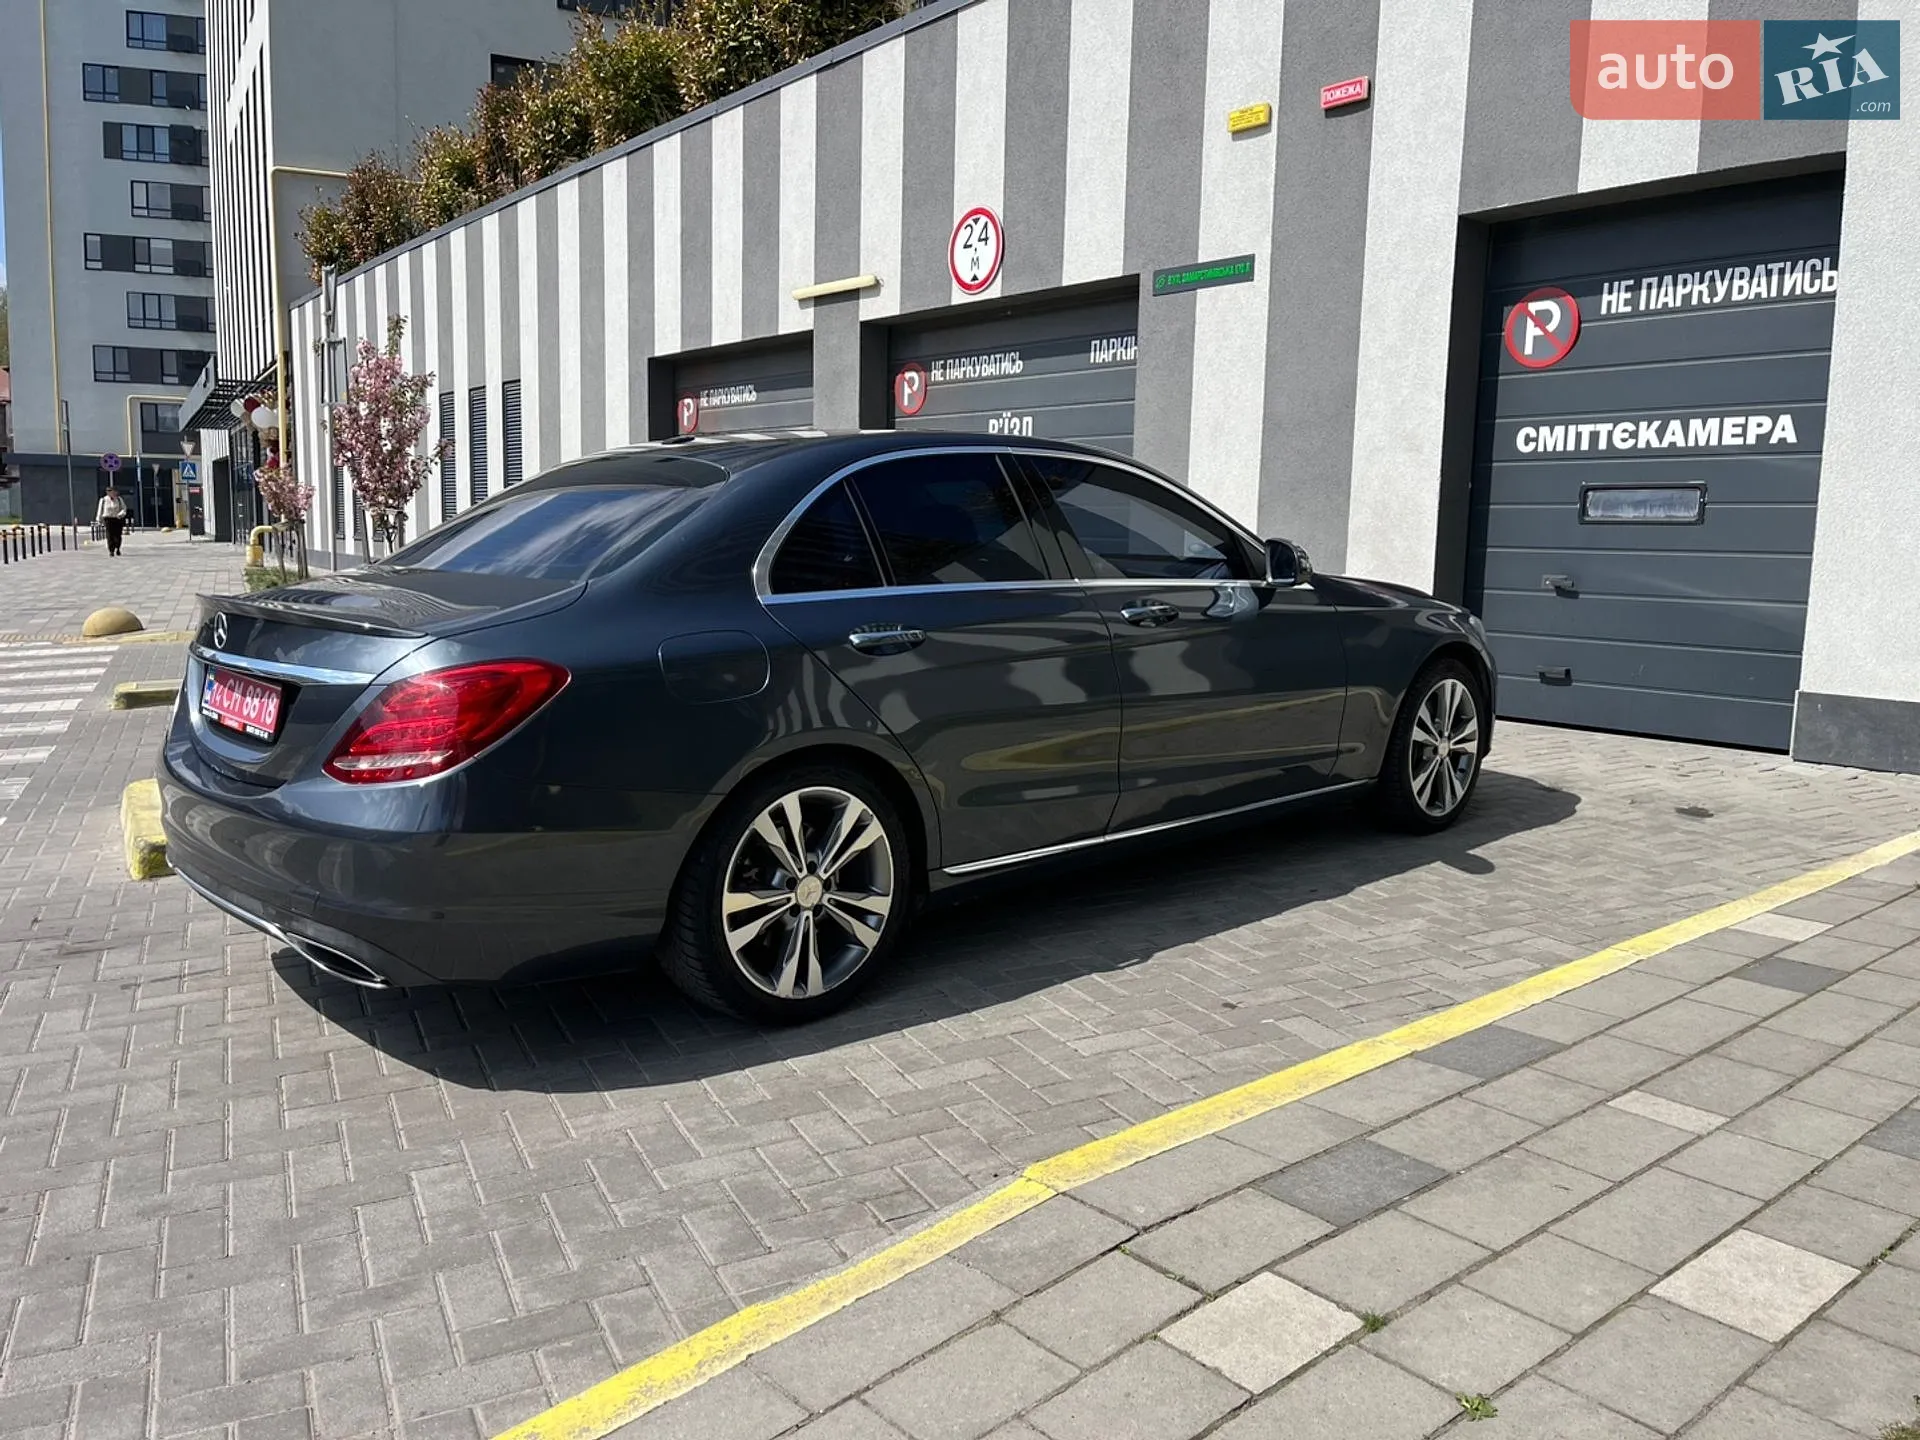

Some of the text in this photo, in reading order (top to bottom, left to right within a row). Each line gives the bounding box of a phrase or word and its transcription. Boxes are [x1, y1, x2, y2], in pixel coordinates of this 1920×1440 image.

[1323, 83, 1361, 101] ПОЖЕЖА
[1600, 257, 1838, 315] НЕ ПАРКУВАТИСЬ
[930, 351, 1023, 382] НЕ ПАРКУВАТИСЬ
[1516, 414, 1798, 453] СМІТТЄКАМЕРА
